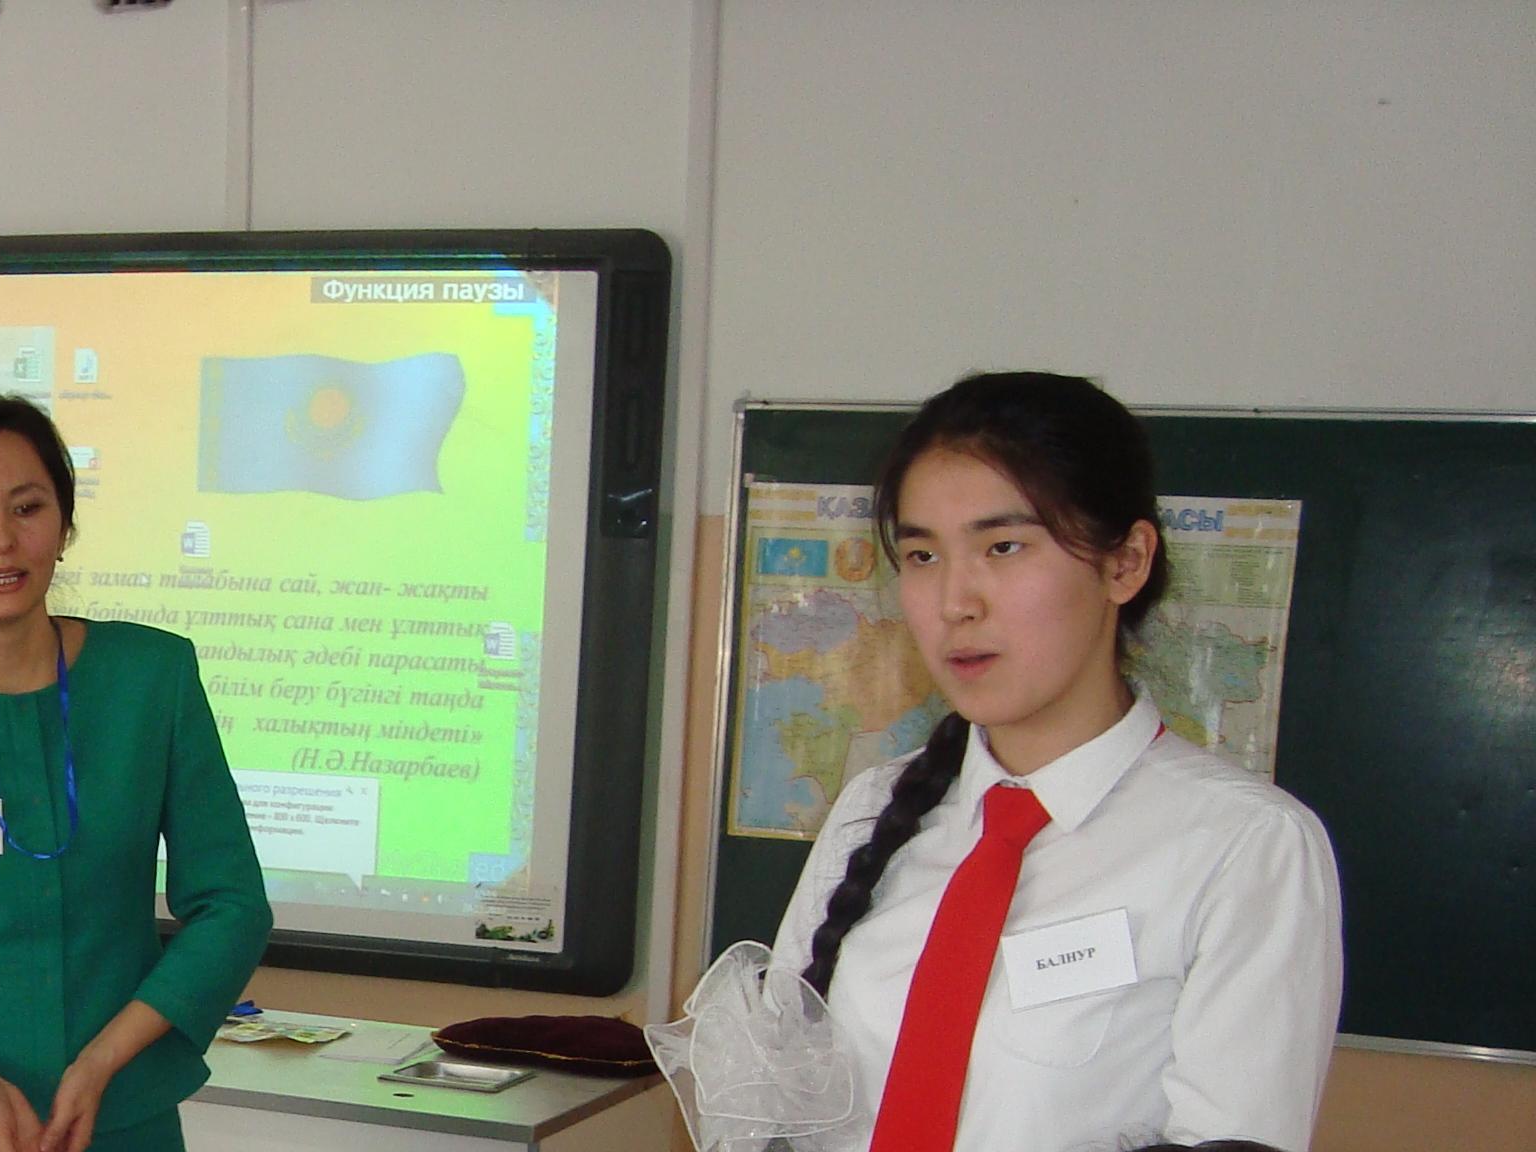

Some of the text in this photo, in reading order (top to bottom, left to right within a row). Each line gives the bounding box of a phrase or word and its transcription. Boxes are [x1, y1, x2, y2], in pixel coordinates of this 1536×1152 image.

[322, 279, 524, 302] Функция паузы
[90, 571, 152, 587] заман
[279, 573, 321, 595] сай,
[397, 582, 489, 603] жақты
[184, 608, 277, 632] ұлттық
[283, 613, 334, 632] сана
[338, 616, 384, 633] мен
[302, 643, 361, 667] әдебі
[208, 675, 485, 713] білім беру бүгінгі таңда
[253, 716, 371, 742] халықтың
[376, 720, 482, 745] міндеті»
[291, 746, 480, 784] (Н.Ә.Назарбаев)
[1035, 947, 1097, 971] БАЛНУР
